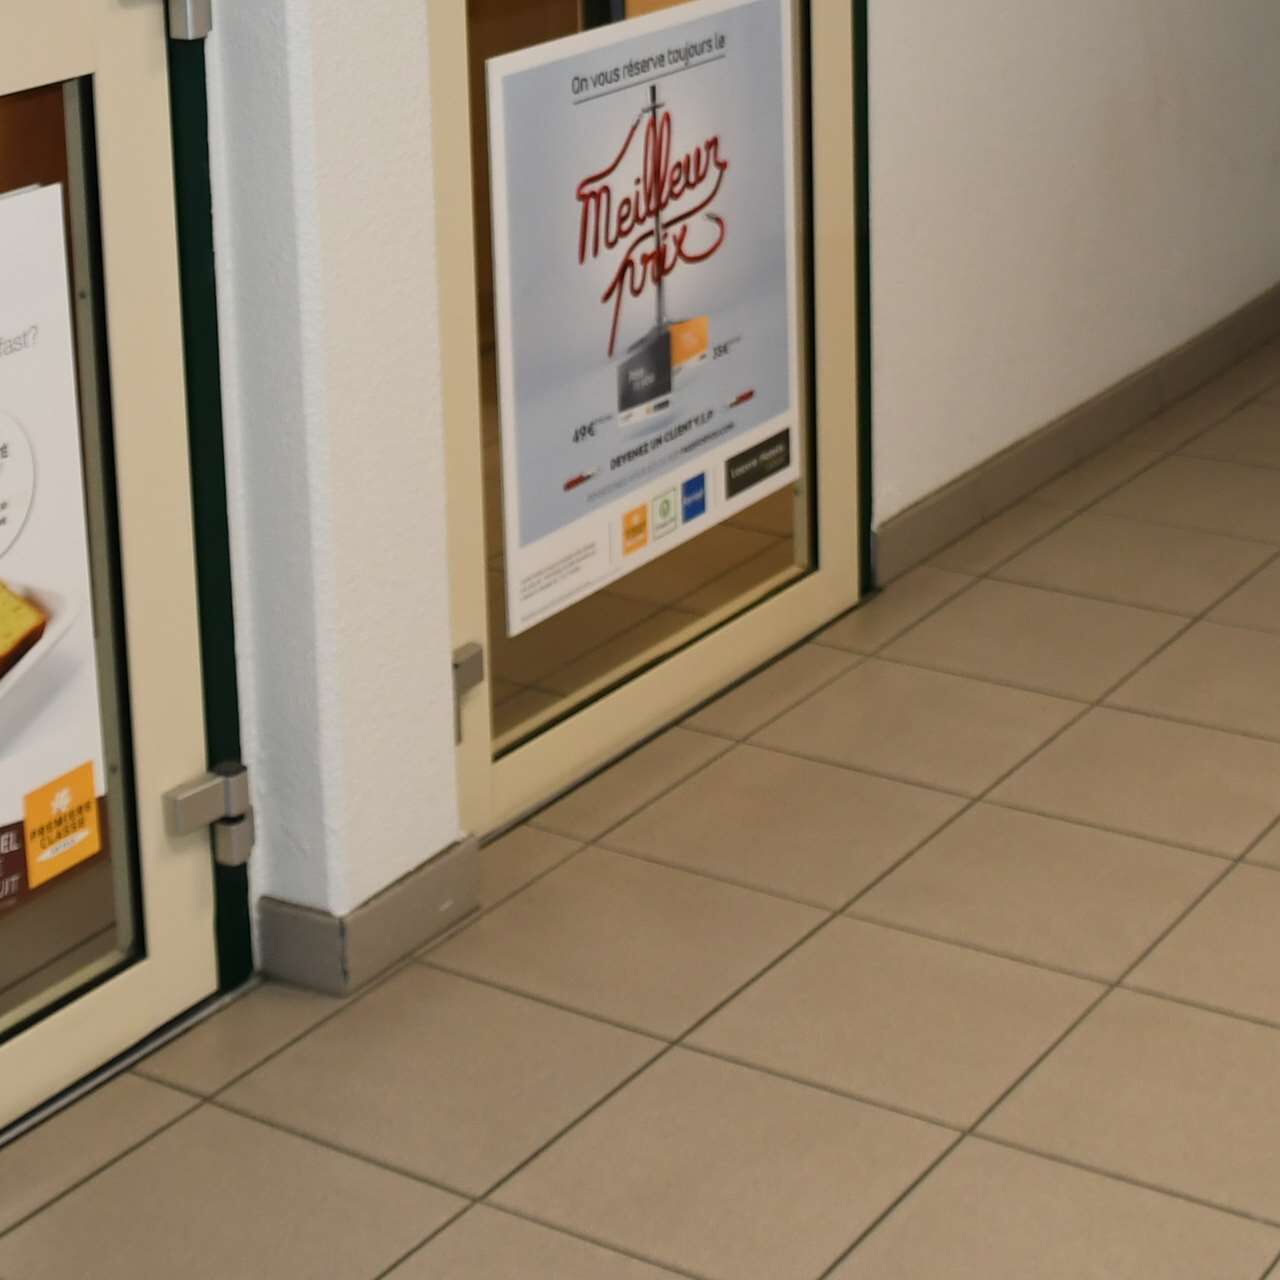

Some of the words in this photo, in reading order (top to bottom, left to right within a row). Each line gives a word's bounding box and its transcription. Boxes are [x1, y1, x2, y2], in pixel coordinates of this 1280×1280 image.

[571, 76, 588, 95] On
[591, 67, 620, 87] vous
[622, 56, 666, 80] réserve
[667, 42, 713, 67] toujours
[713, 33, 726, 51] le
[577, 112, 728, 265] Meilleur
